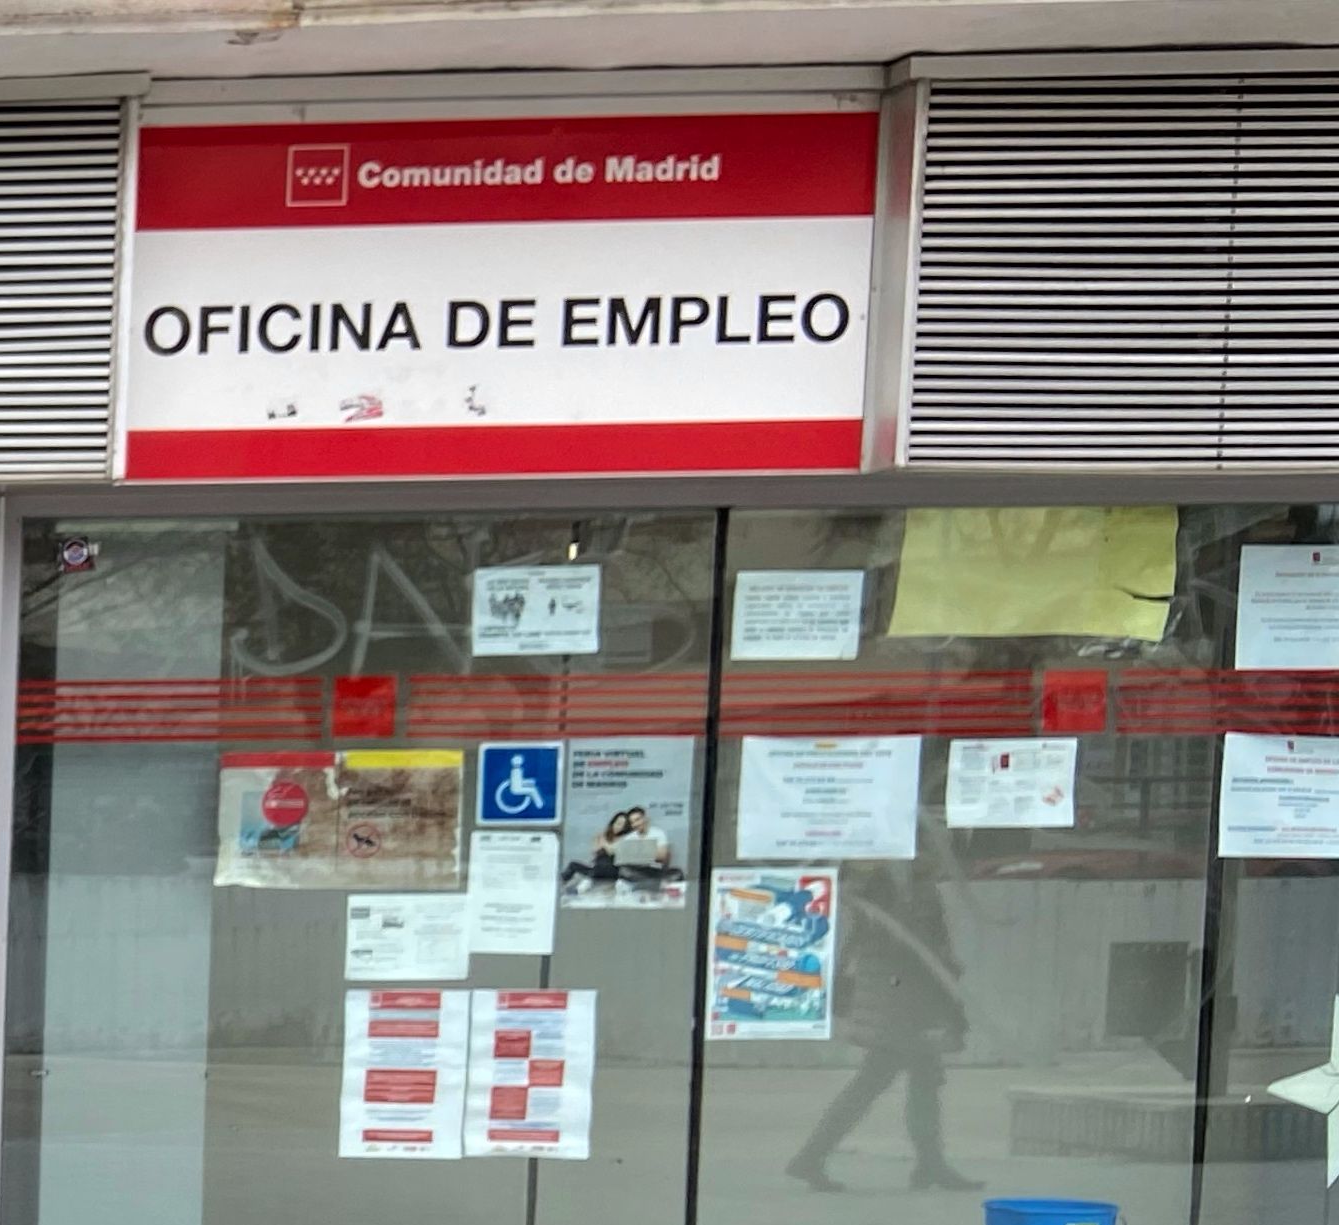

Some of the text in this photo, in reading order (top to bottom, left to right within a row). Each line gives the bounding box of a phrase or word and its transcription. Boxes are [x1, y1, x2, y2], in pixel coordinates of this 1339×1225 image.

[357, 154, 721, 188] Comunidad de Madrid
[144, 293, 850, 355] OFICINA DE EMPLEO
